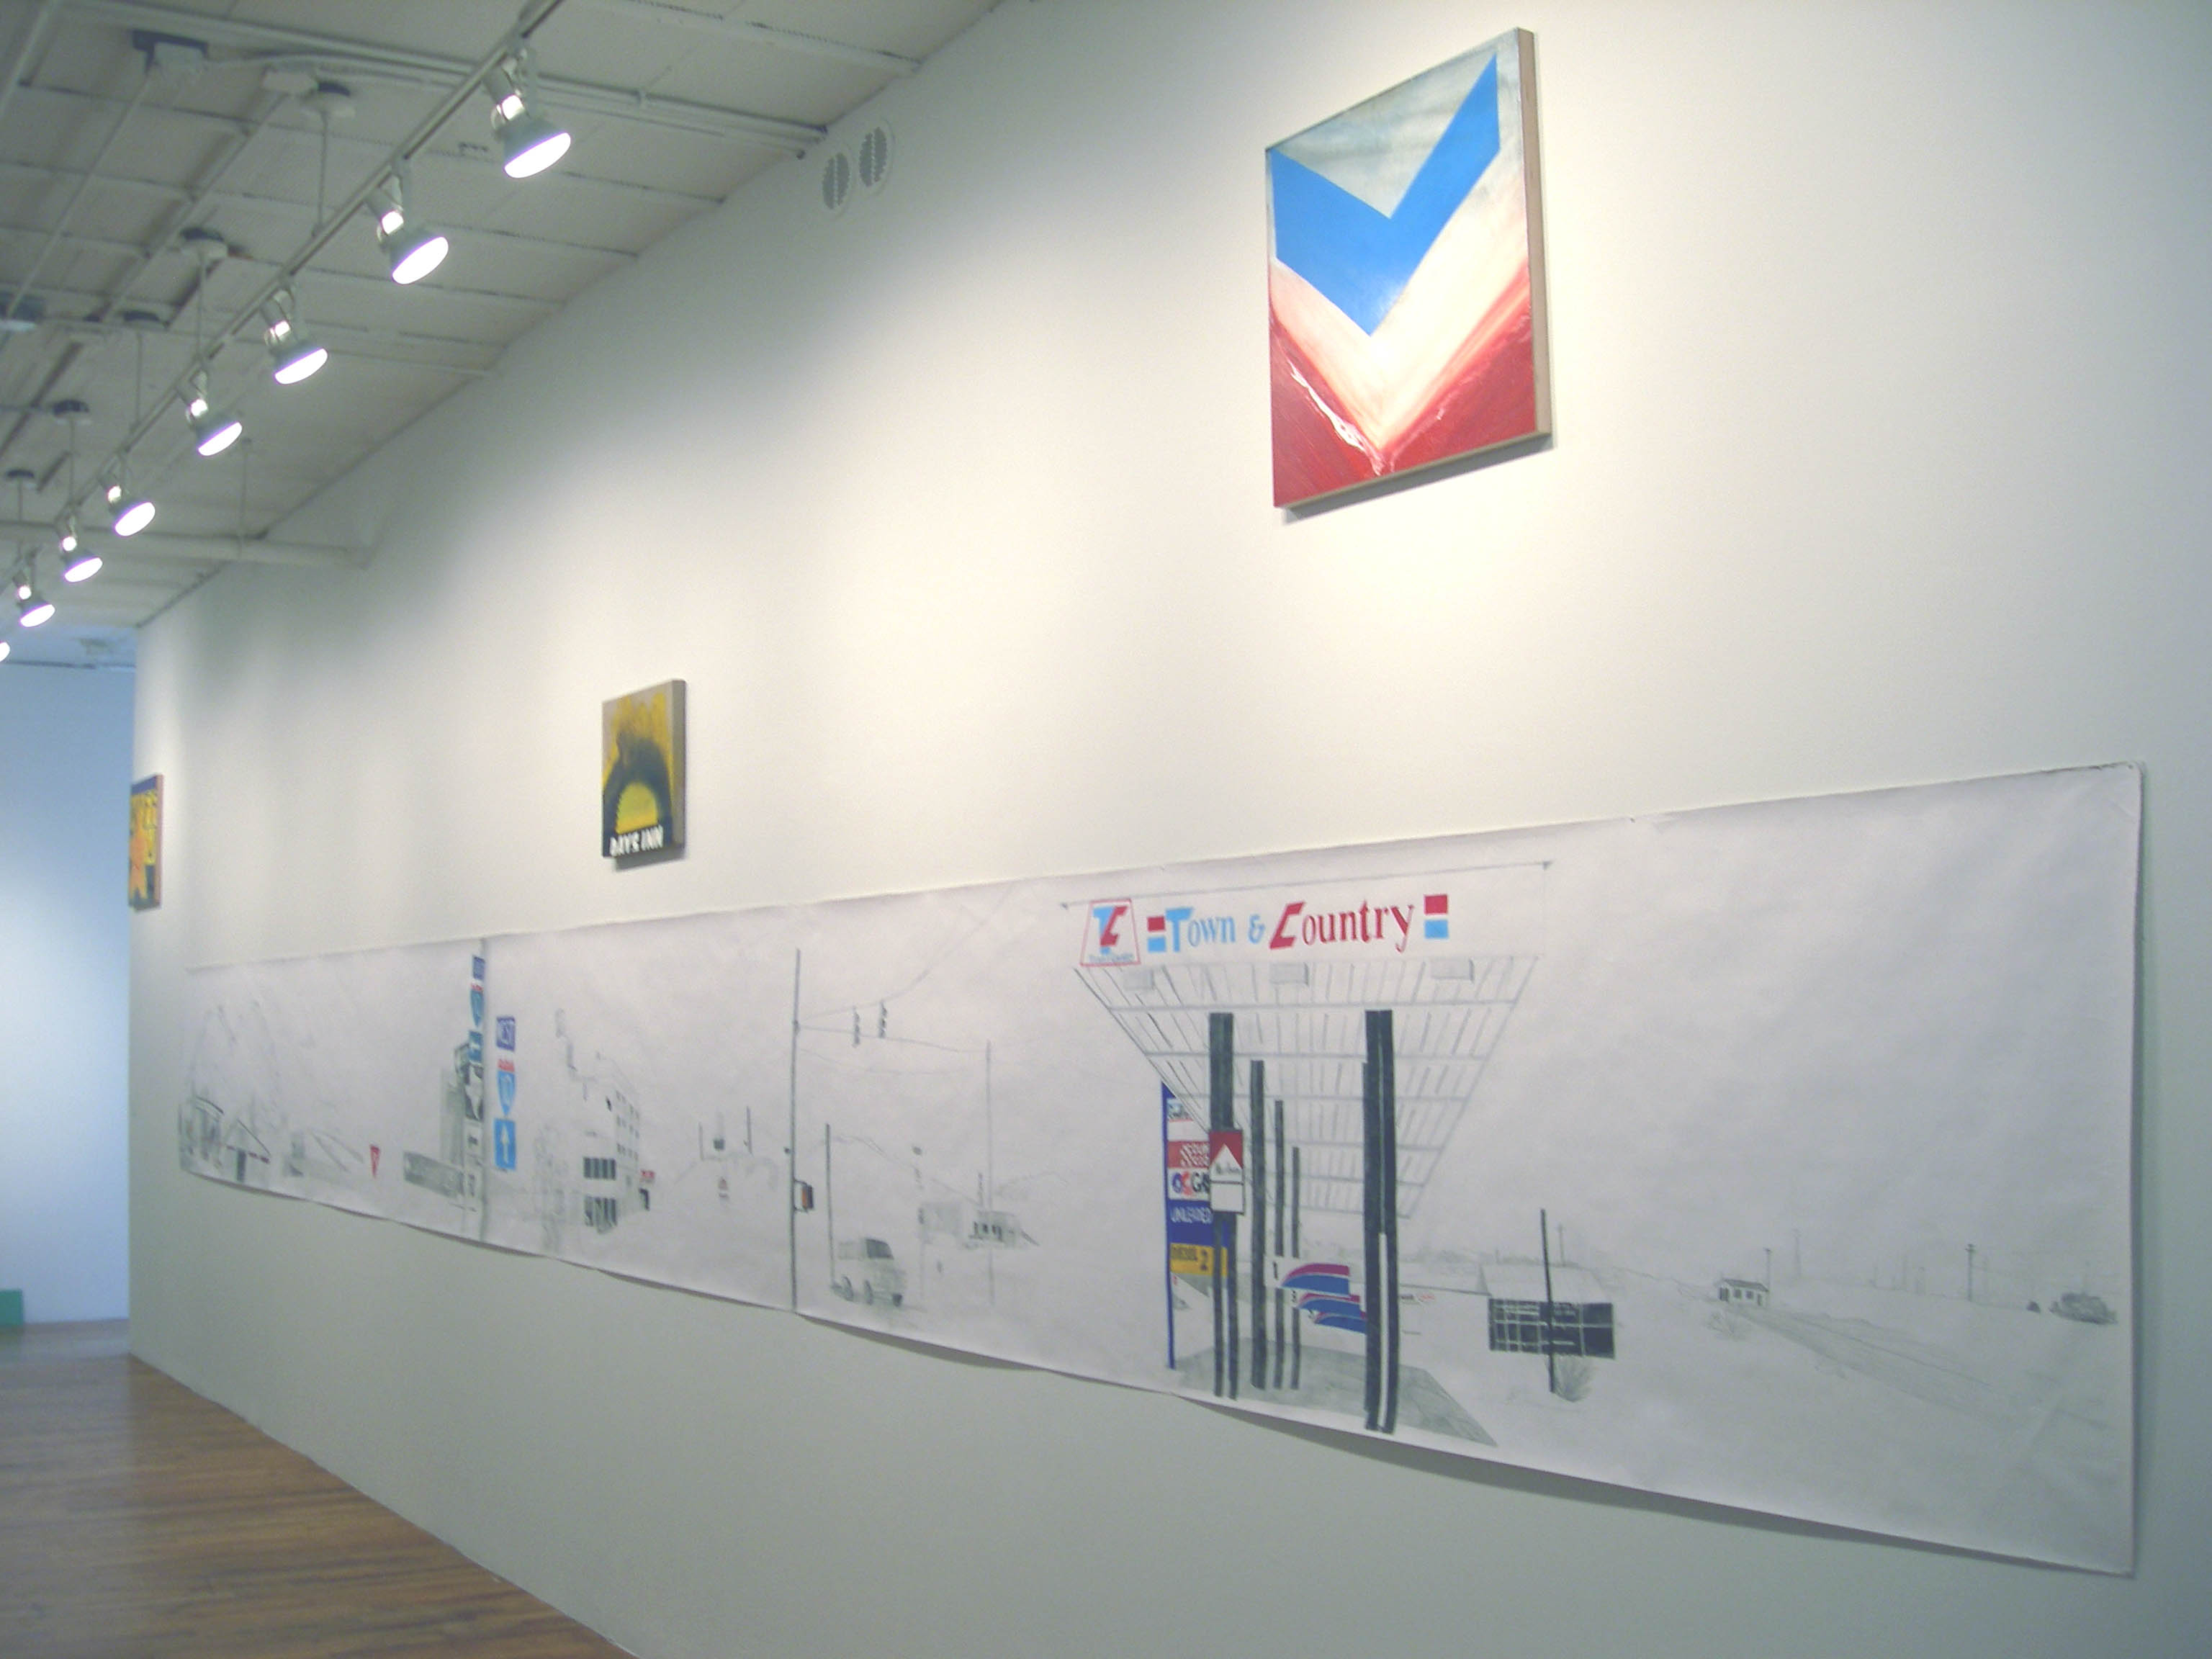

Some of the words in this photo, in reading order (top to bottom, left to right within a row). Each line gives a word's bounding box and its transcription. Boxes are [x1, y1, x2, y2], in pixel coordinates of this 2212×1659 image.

[1165, 907, 1236, 953] Town
[1248, 914, 1265, 944] &
[1269, 899, 1414, 954] Country
